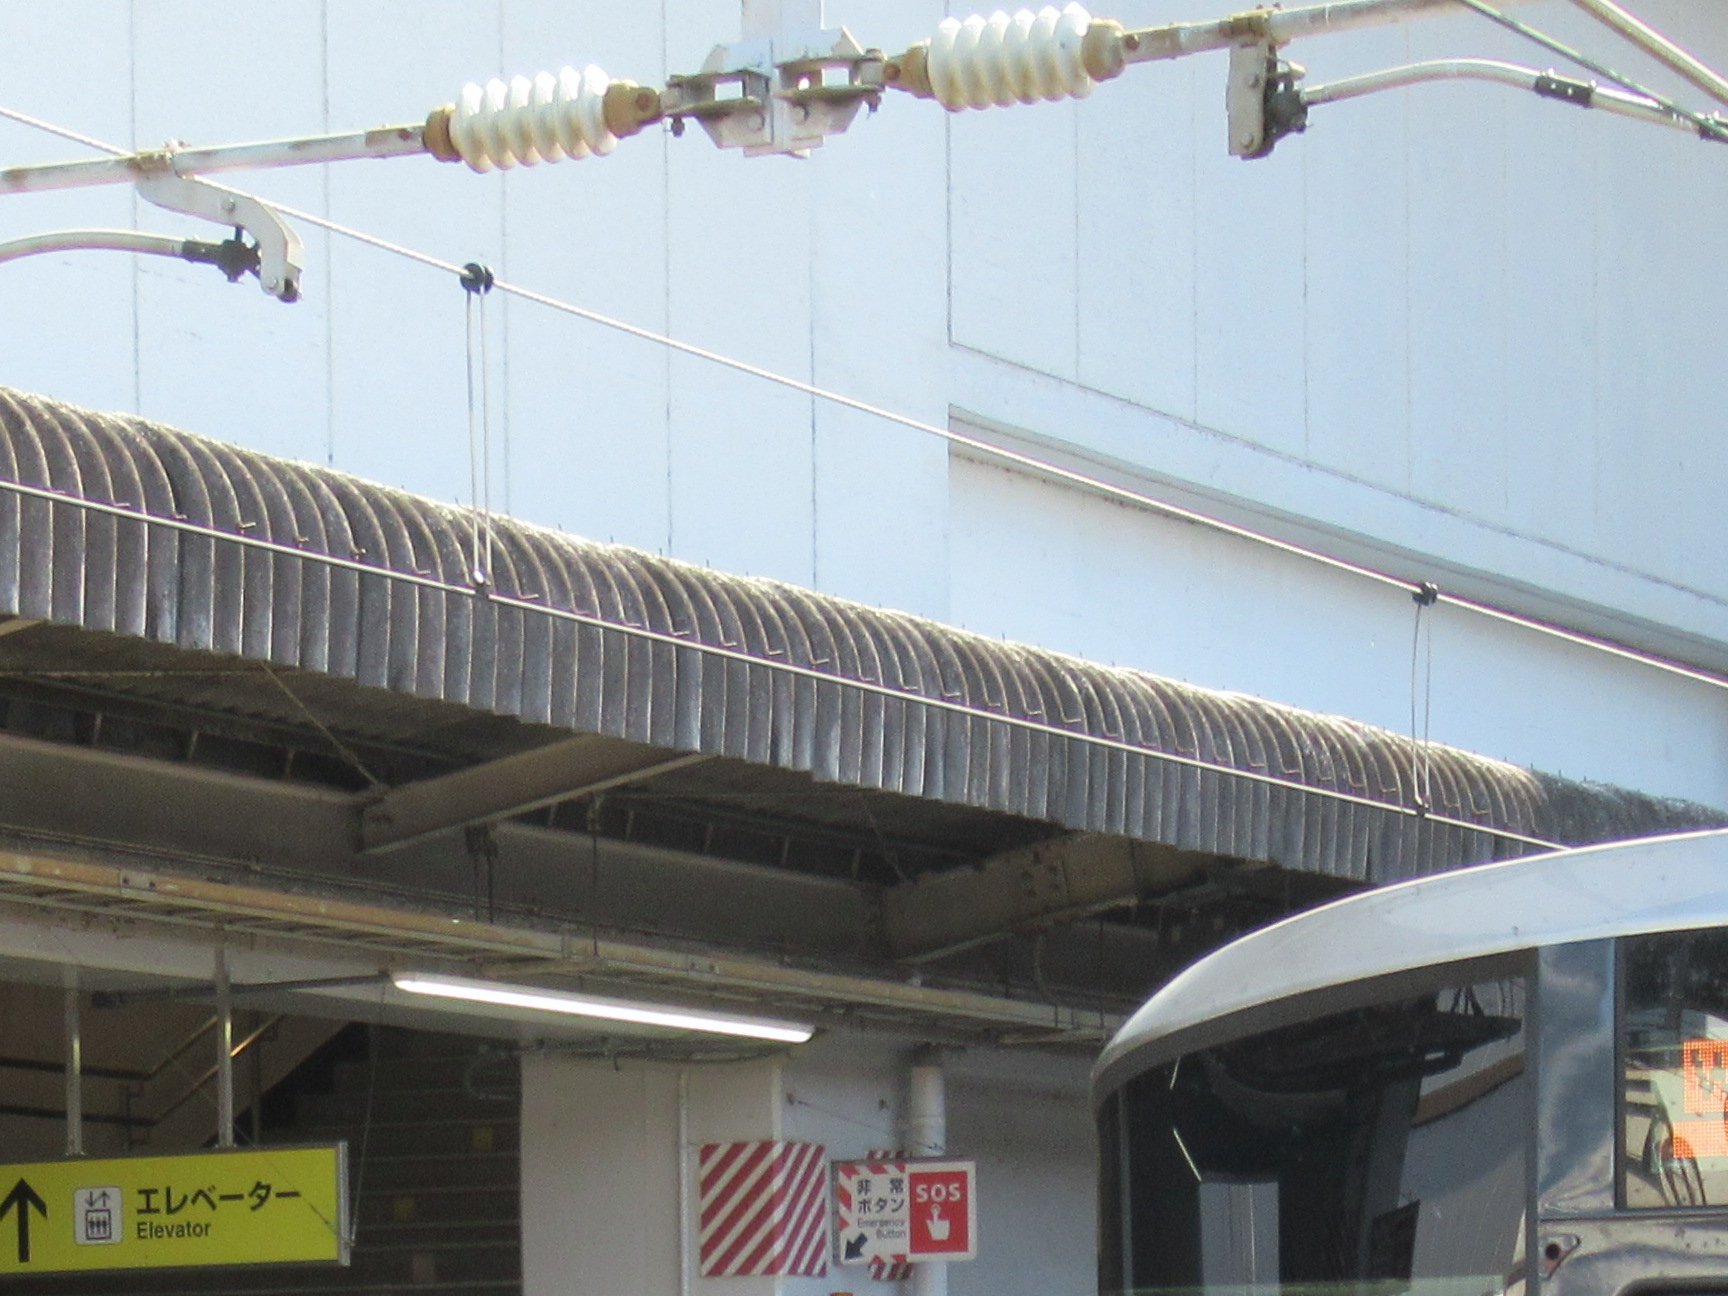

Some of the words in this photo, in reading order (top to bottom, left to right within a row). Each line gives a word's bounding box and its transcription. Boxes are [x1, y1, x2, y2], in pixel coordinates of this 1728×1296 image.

[857, 1178, 904, 1196] 非常
[916, 1183, 961, 1203] SOS
[136, 1180, 301, 1216] エレベーター
[136, 1219, 212, 1240] Elevator
[857, 1217, 905, 1230] Emergency
[876, 1229, 906, 1240] Button
